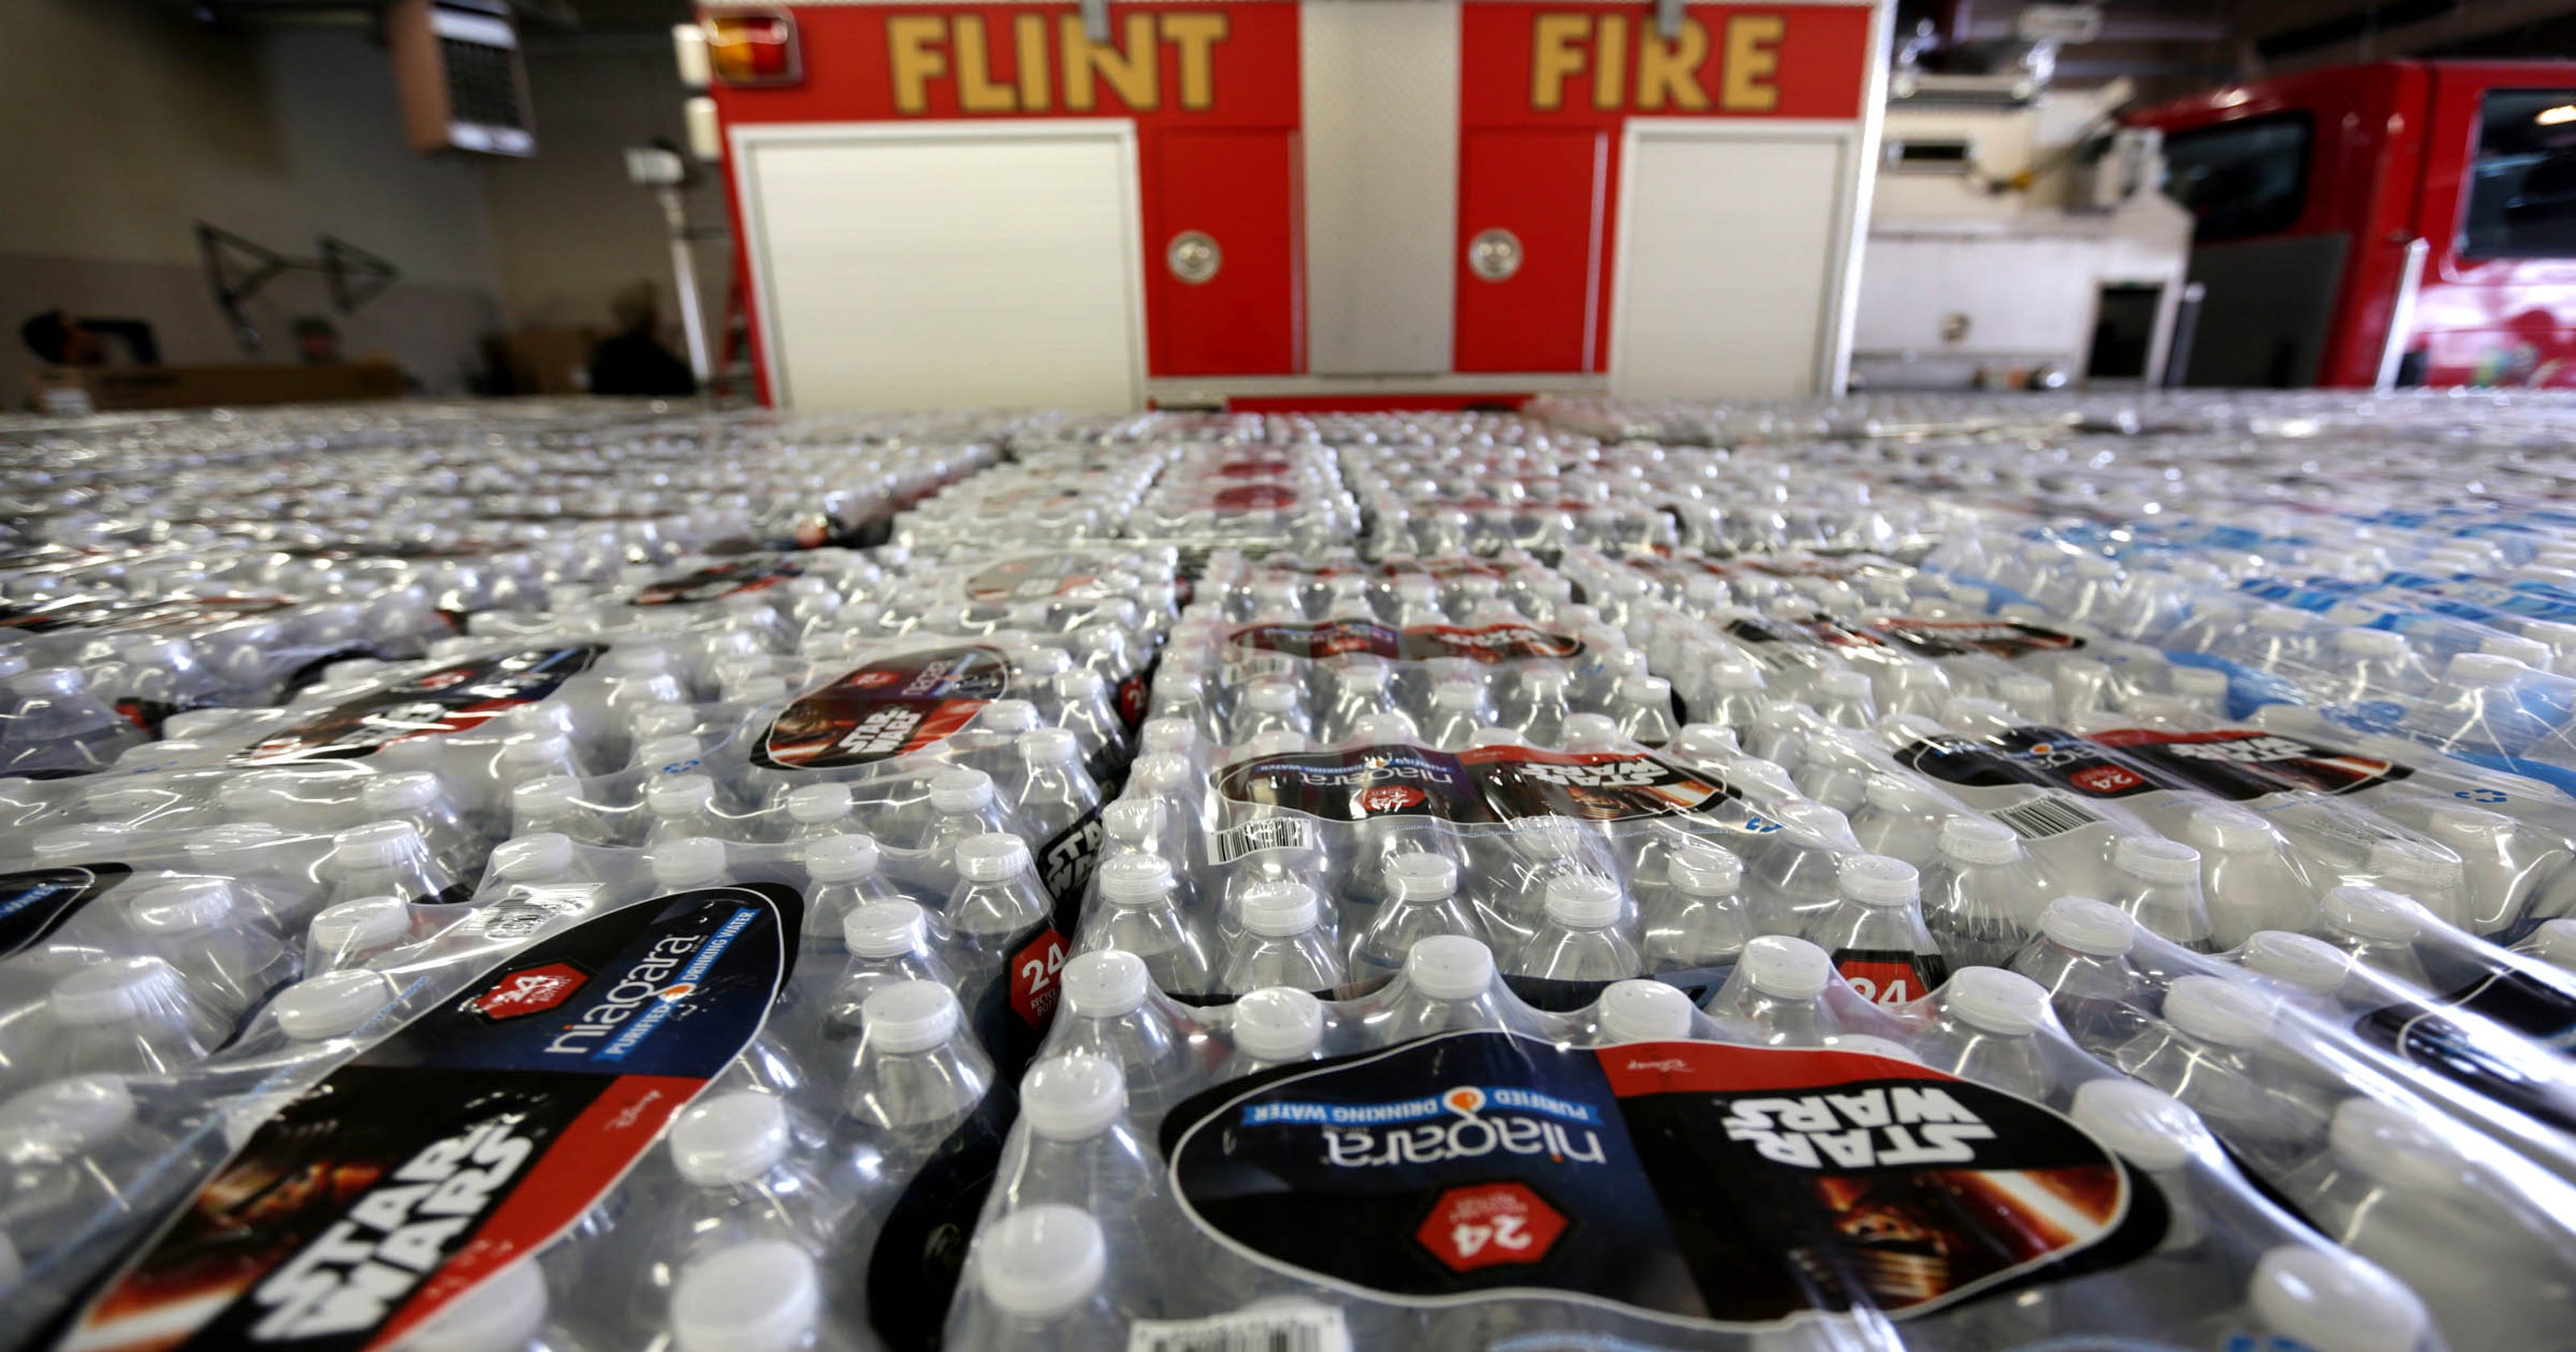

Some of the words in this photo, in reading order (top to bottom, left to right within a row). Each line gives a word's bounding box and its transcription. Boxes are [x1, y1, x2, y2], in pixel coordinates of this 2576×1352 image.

[888, 12, 1228, 113] FLINT
[1533, 13, 1785, 111] FIRE
[1520, 769, 1669, 787] STAR
[1521, 757, 1662, 777] WARS
[2092, 771, 2132, 790] 24
[1046, 819, 1104, 880] STA
[604, 1004, 671, 1056] PURIFIED
[680, 935, 727, 982] DRINKING
[723, 910, 755, 938] WATER
[1022, 942, 1067, 995] 24
[544, 934, 700, 1054] niagara
[1253, 1103, 1327, 1126] WATER
[1331, 1096, 1439, 1124] DRINKING
[1494, 1088, 1589, 1119] PURIFIED
[1720, 1086, 1984, 1132] WARS
[1321, 1109, 1607, 1169] niagara
[1727, 1123, 1998, 1169] STAR
[251, 1120, 493, 1341] STAR
[283, 1123, 535, 1338] WARS
[1450, 1214, 1534, 1259] 24
